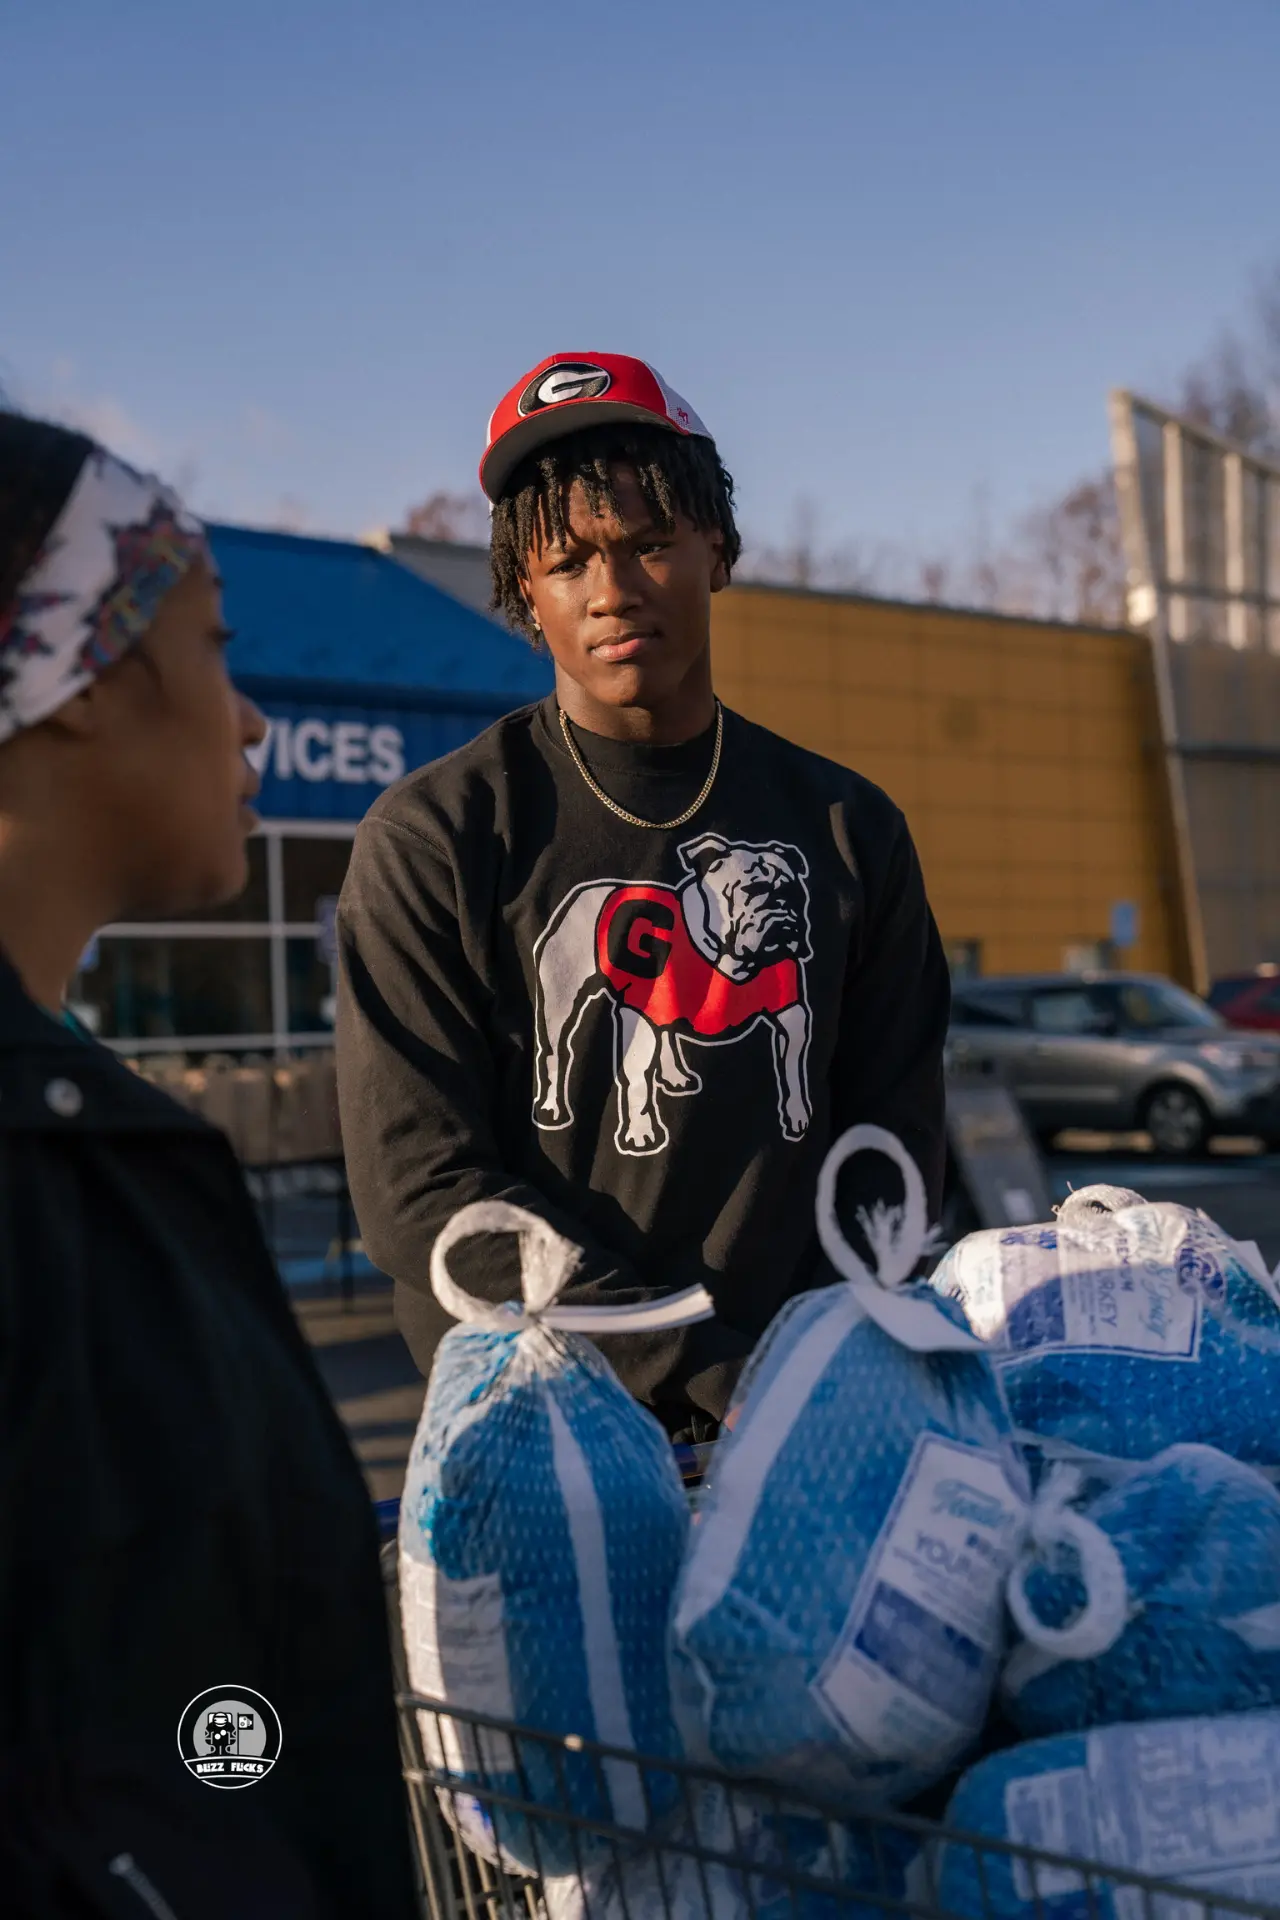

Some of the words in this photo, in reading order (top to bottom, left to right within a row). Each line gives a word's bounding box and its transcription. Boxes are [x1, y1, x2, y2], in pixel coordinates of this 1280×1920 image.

[535, 368, 609, 406] G
[608, 898, 675, 980] G
[1115, 1230, 1134, 1292] PREMUM
[1096, 1265, 1118, 1329] URKEY
